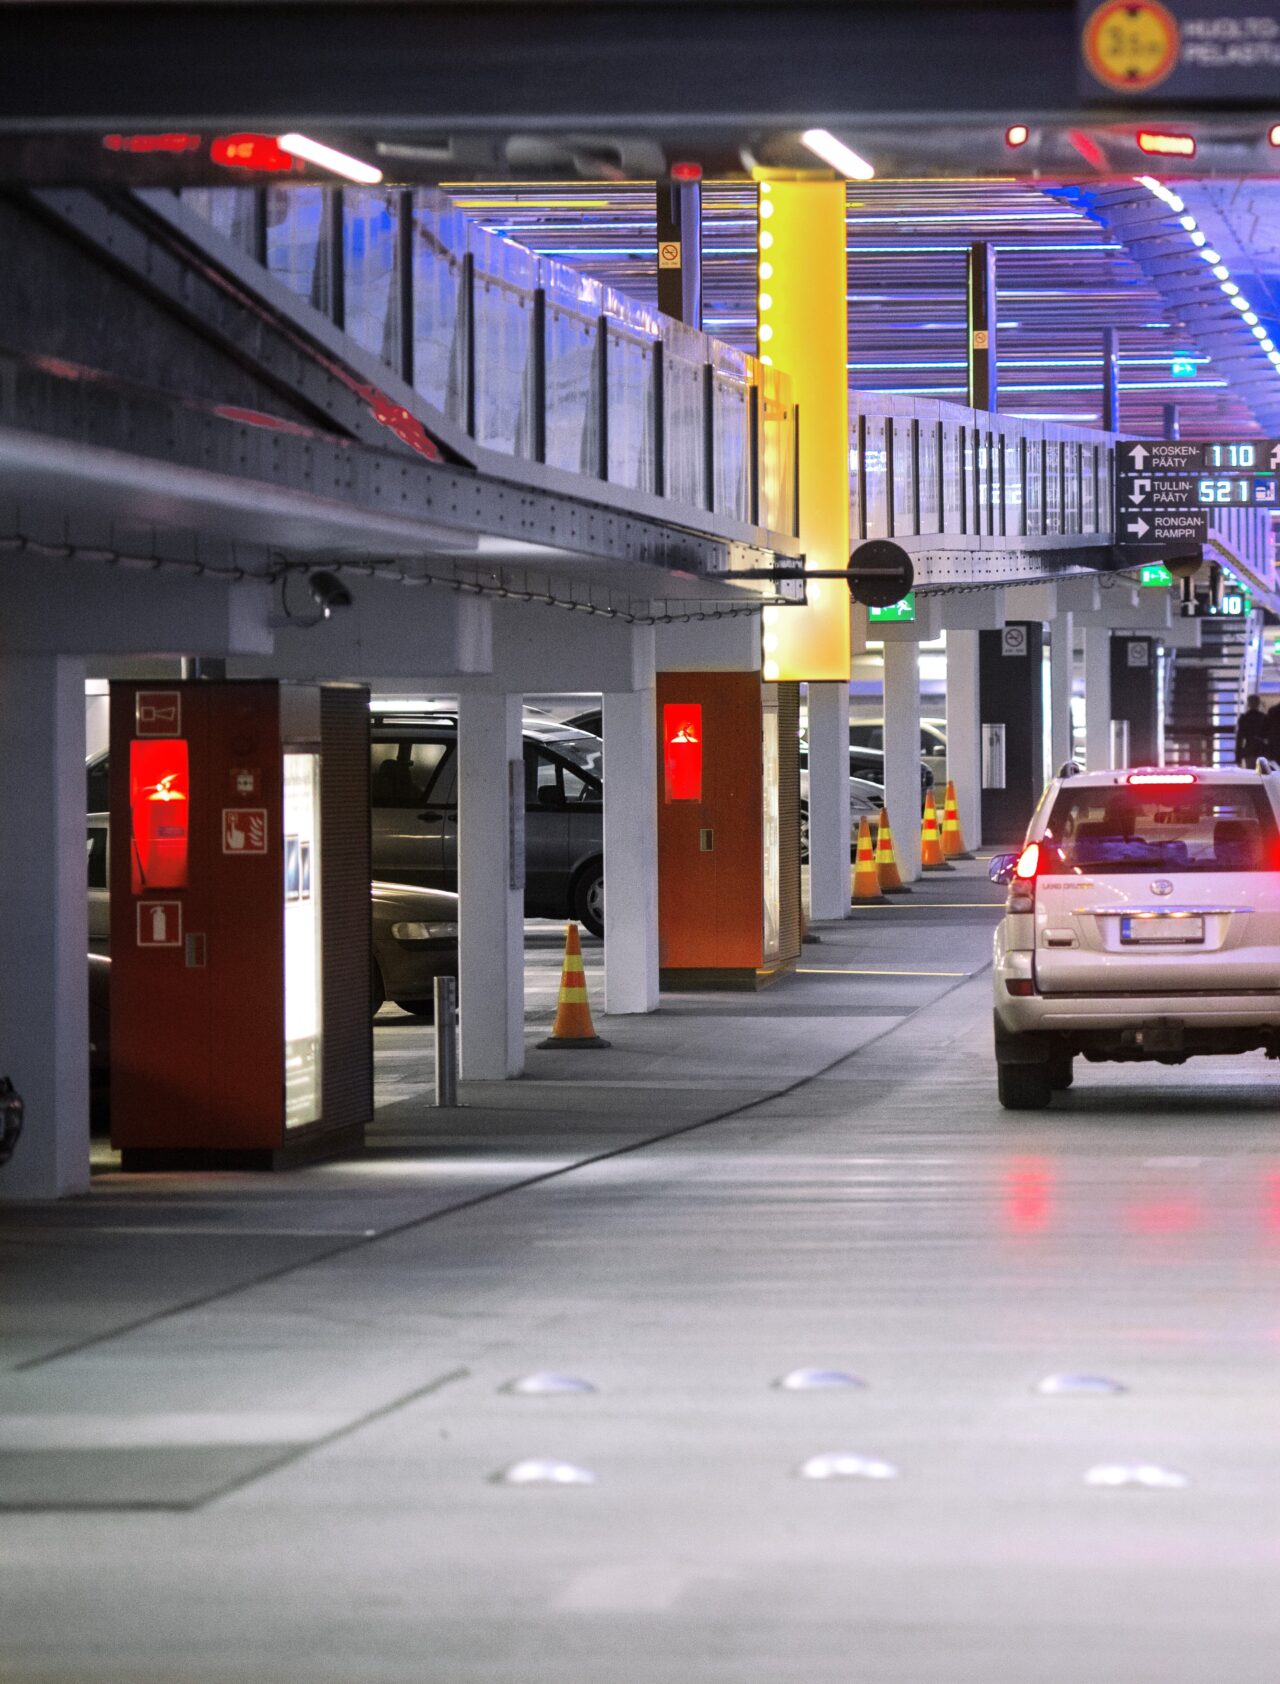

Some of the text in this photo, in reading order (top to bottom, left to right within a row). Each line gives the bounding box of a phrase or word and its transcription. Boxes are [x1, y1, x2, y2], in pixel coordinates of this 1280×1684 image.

[1152, 446, 1200, 456] KOSKEN-
[1212, 445, 1254, 467] 110
[1152, 457, 1188, 467] PÄÄTY
[1153, 481, 1193, 491] TULLIN-
[1200, 480, 1248, 502] 521
[1153, 492, 1189, 502] PÄÄTY
[1155, 517, 1205, 527] RONGAN-
[1155, 528, 1196, 538] RAMPPI
